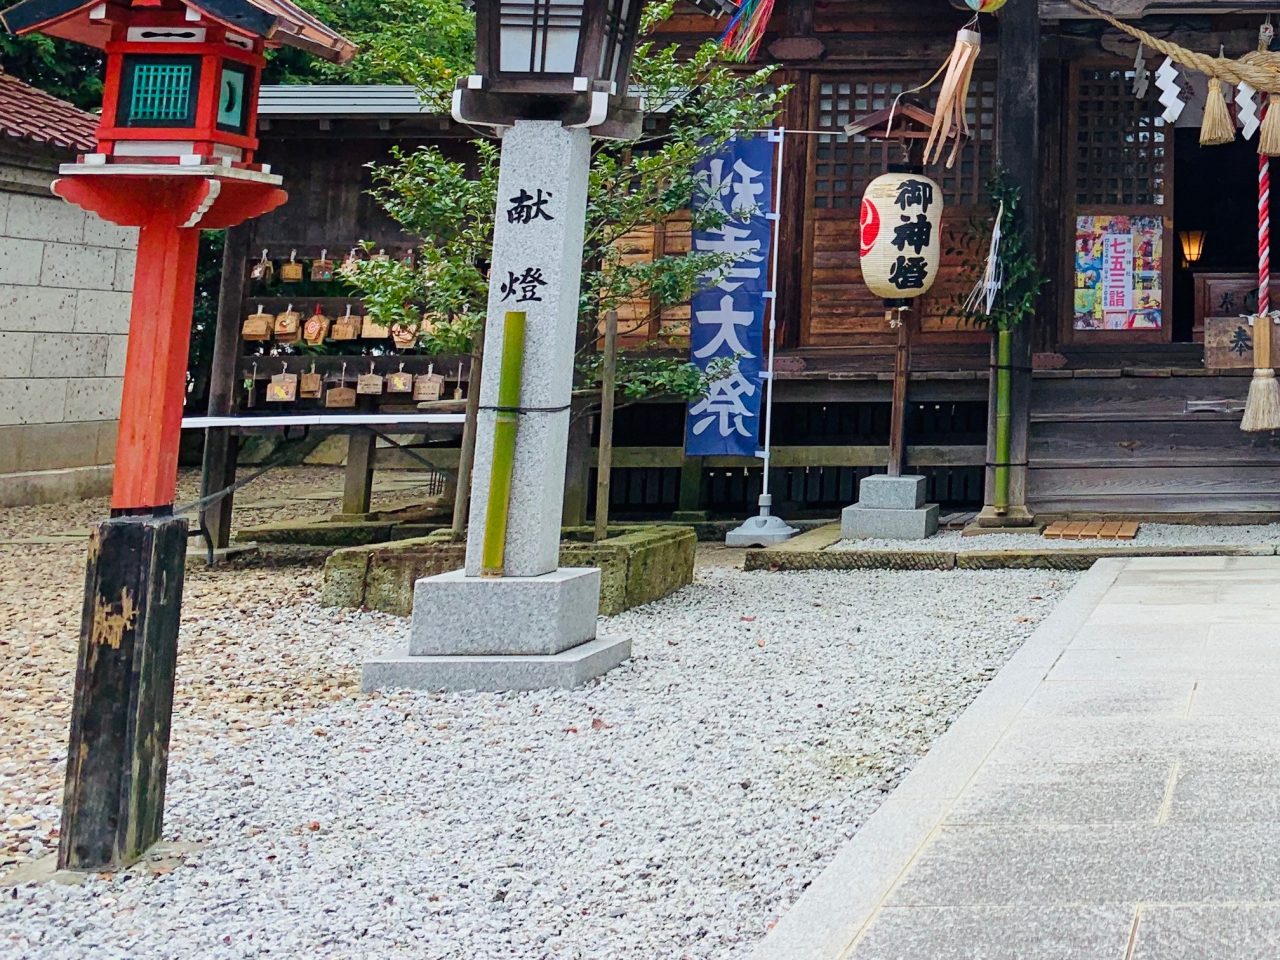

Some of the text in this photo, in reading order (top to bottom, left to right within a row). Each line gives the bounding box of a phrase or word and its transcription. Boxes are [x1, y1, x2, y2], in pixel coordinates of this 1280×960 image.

[500, 188, 555, 302] 献燈
[1109, 238, 1127, 307] 七五三詣
[1229, 326, 1254, 357] 奉
